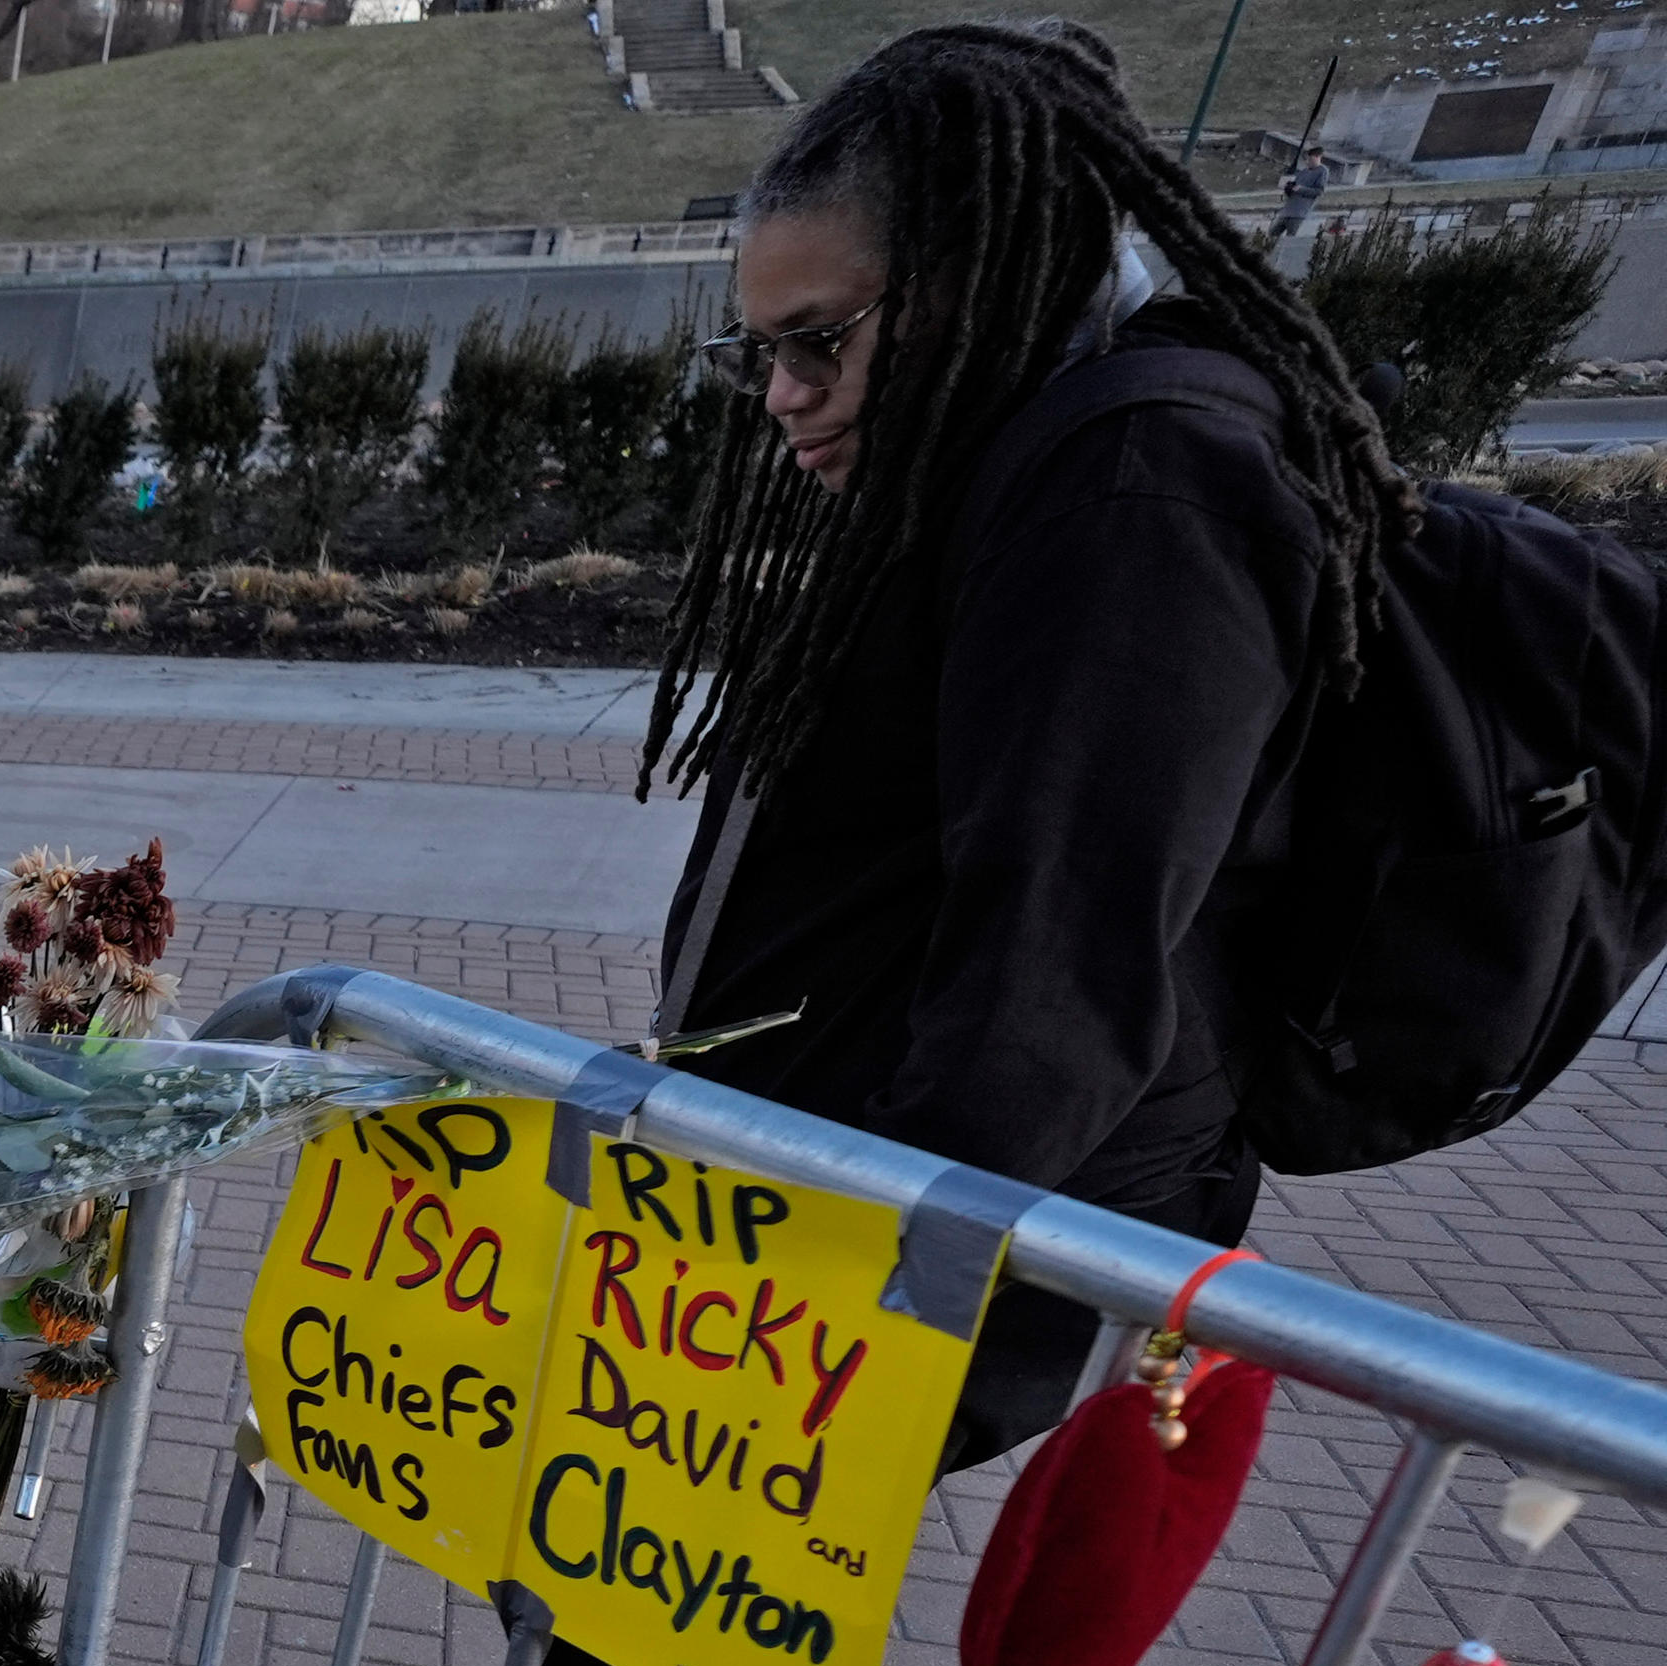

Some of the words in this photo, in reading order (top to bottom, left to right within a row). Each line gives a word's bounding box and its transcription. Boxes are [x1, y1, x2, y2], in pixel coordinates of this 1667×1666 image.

[301, 1159, 510, 1326] Lisa
[286, 1390, 430, 1522] Fans
[567, 1334, 828, 1526] David
[528, 1453, 835, 1666] Clayton
[806, 1535, 866, 1579] and
